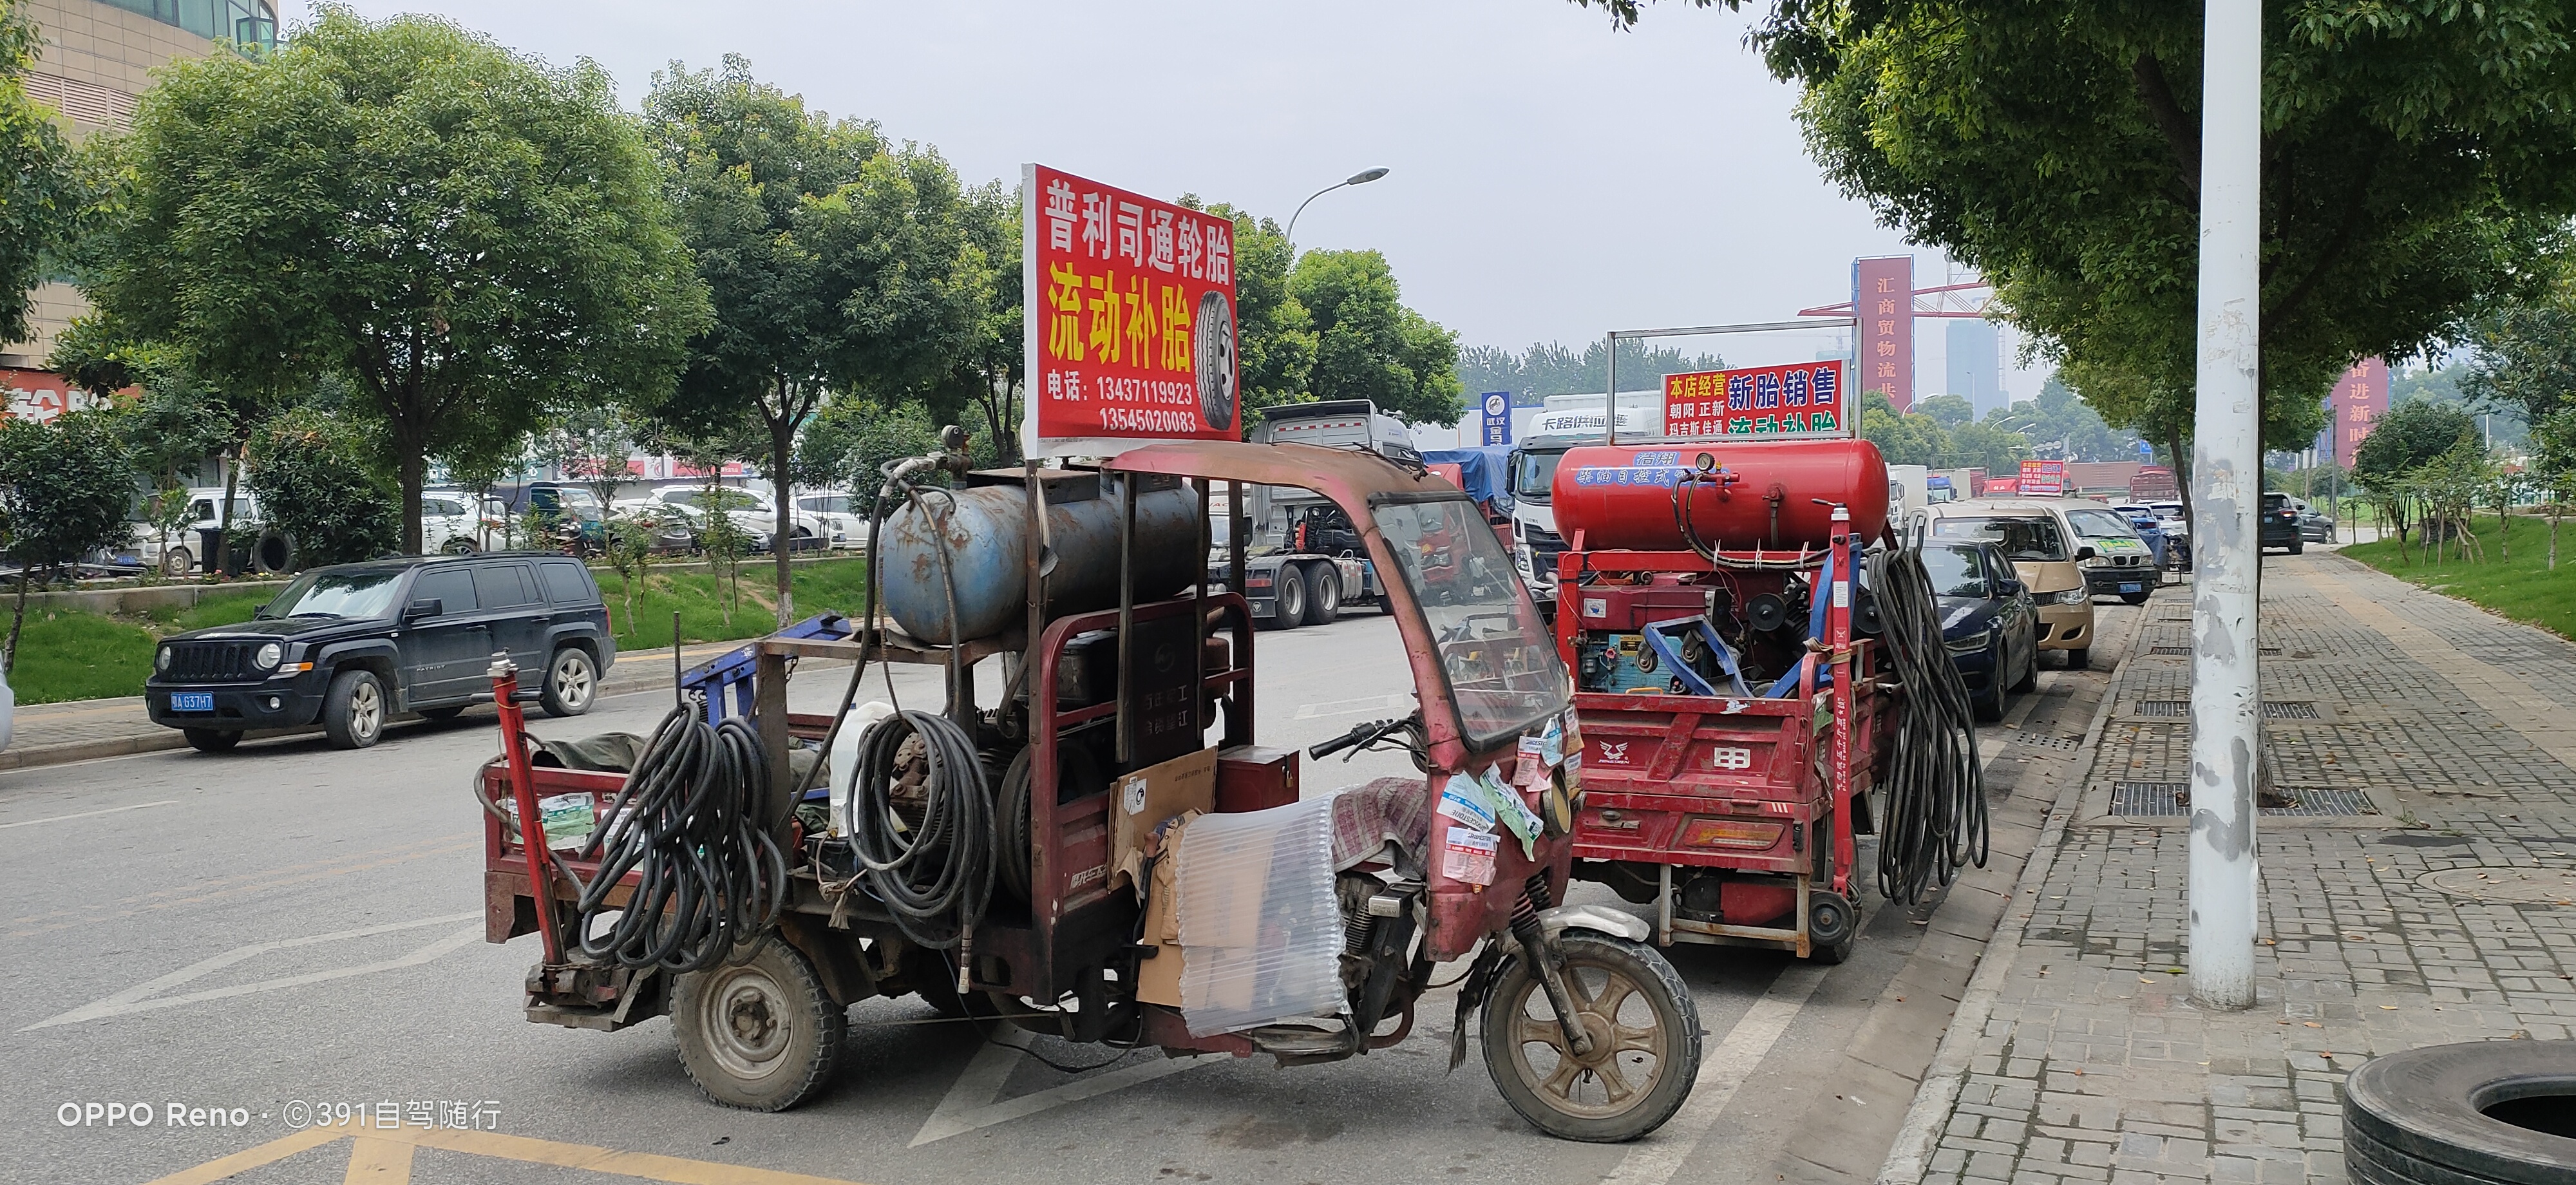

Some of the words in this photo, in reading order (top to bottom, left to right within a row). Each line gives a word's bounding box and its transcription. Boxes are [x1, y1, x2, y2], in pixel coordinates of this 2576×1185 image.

[1045, 178, 1231, 286] 普利司通轮胎
[1048, 260, 1191, 373] 流动补胎
[1097, 376, 1193, 406] 13437119923
[1670, 373, 1727, 399] 本店经营
[1728, 366, 1836, 411] 新胎销售
[1099, 409, 1197, 433] 13545020083
[1486, 417, 1505, 426] 武汉
[1669, 403, 1694, 419] 朝阳
[1698, 401, 1725, 417] 正新
